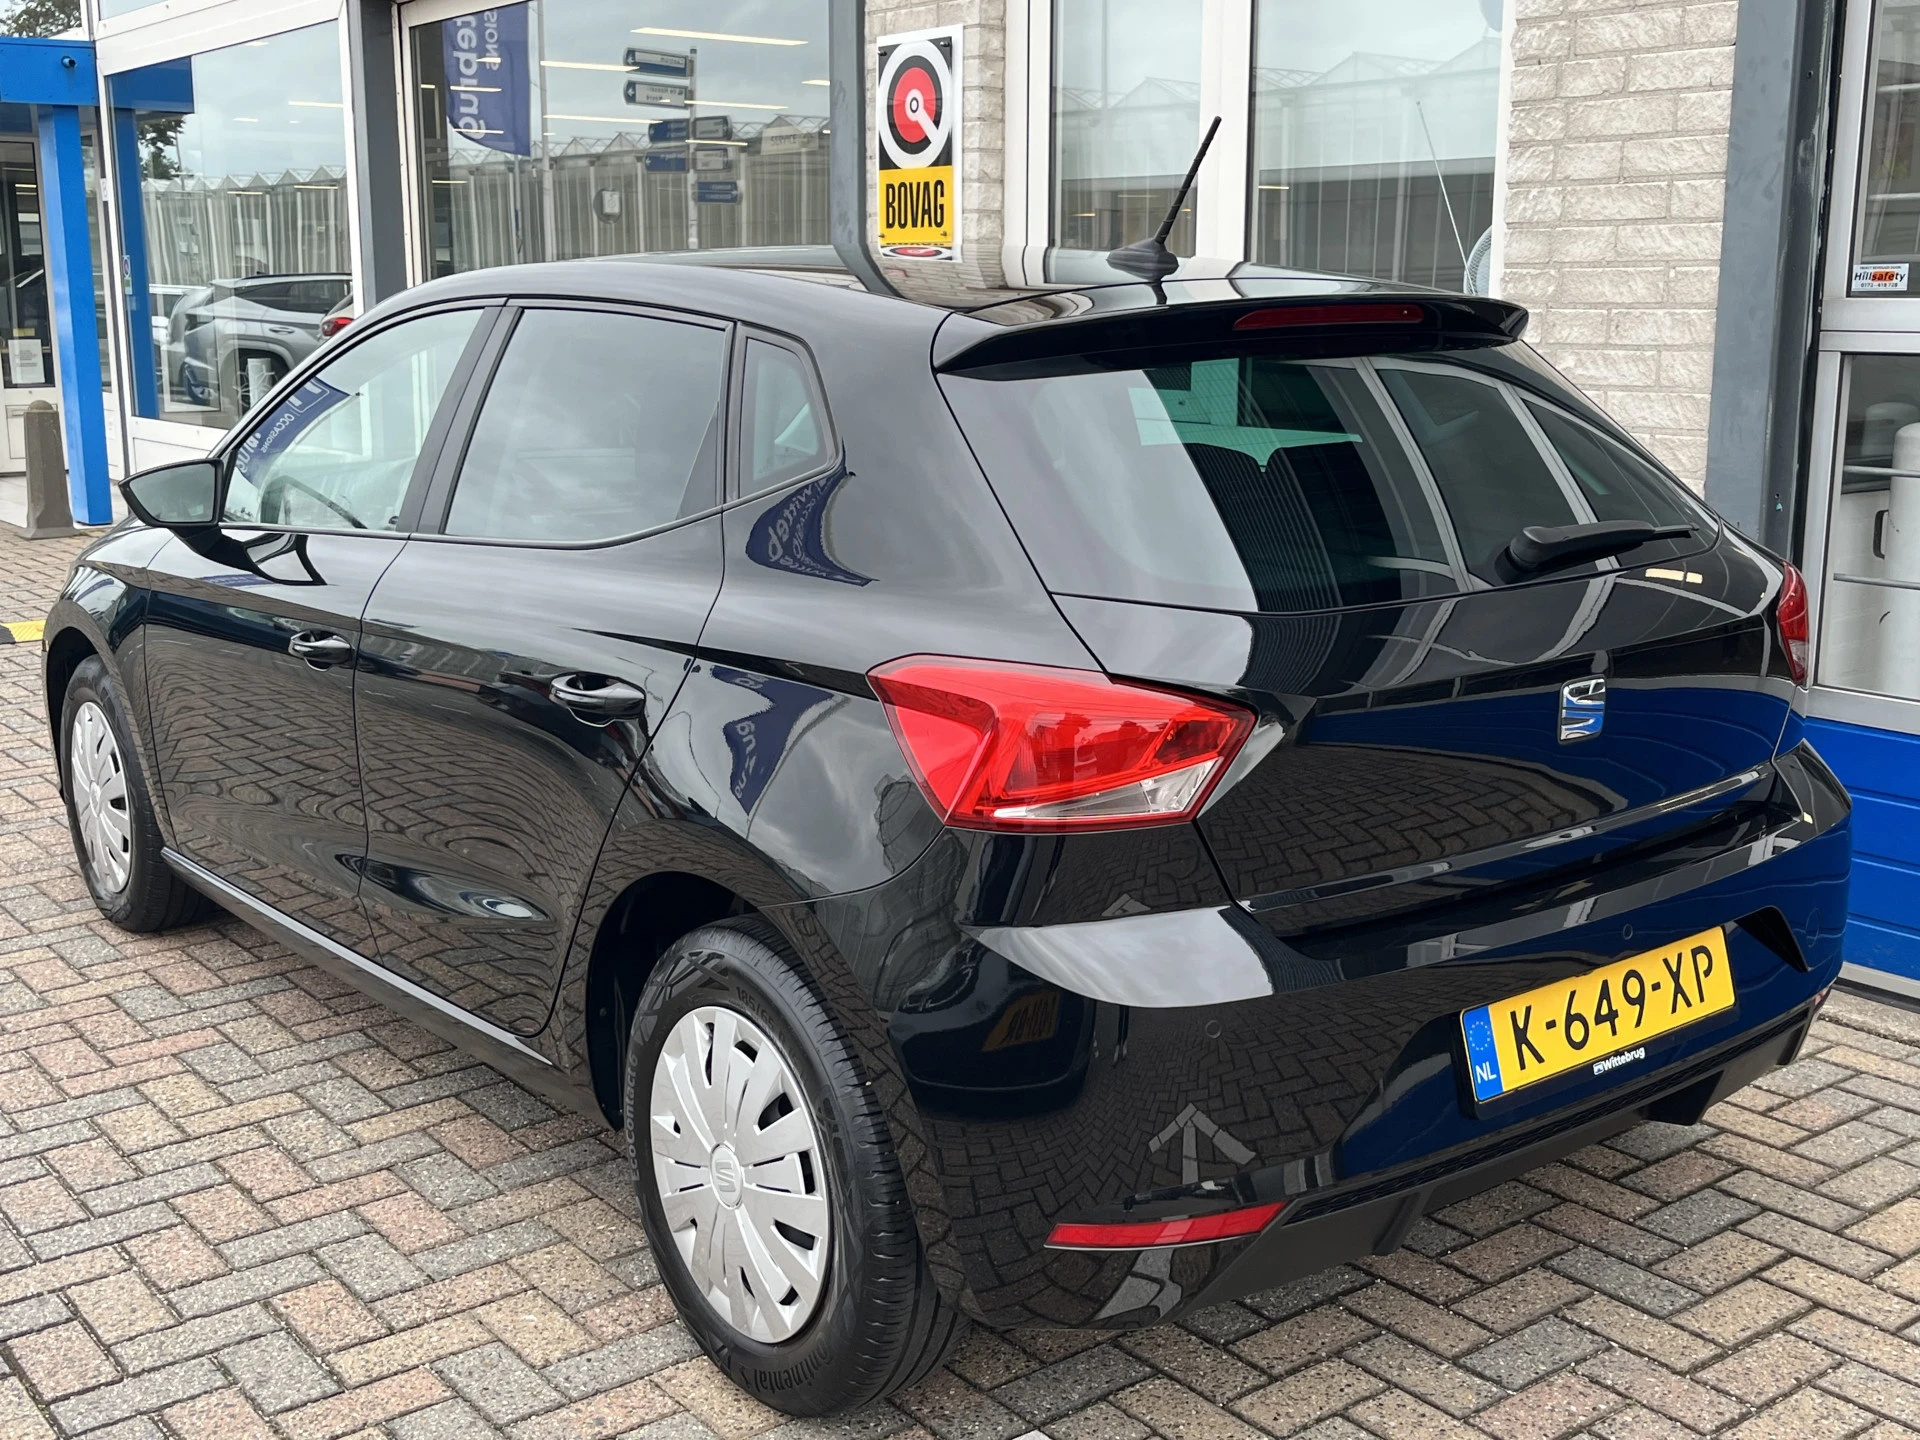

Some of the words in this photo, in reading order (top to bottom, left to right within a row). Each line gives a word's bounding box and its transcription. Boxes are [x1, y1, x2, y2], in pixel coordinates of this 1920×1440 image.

[885, 179, 945, 229] BOVAG
[1854, 270, 1906, 282] Hillsafety
[1509, 945, 1714, 1071] K-649-XP
[628, 1051, 639, 1066] 6
[1603, 1046, 1646, 1071] Wittebrug
[1475, 1061, 1497, 1084] NL
[625, 1068, 640, 1181] EcoContact
